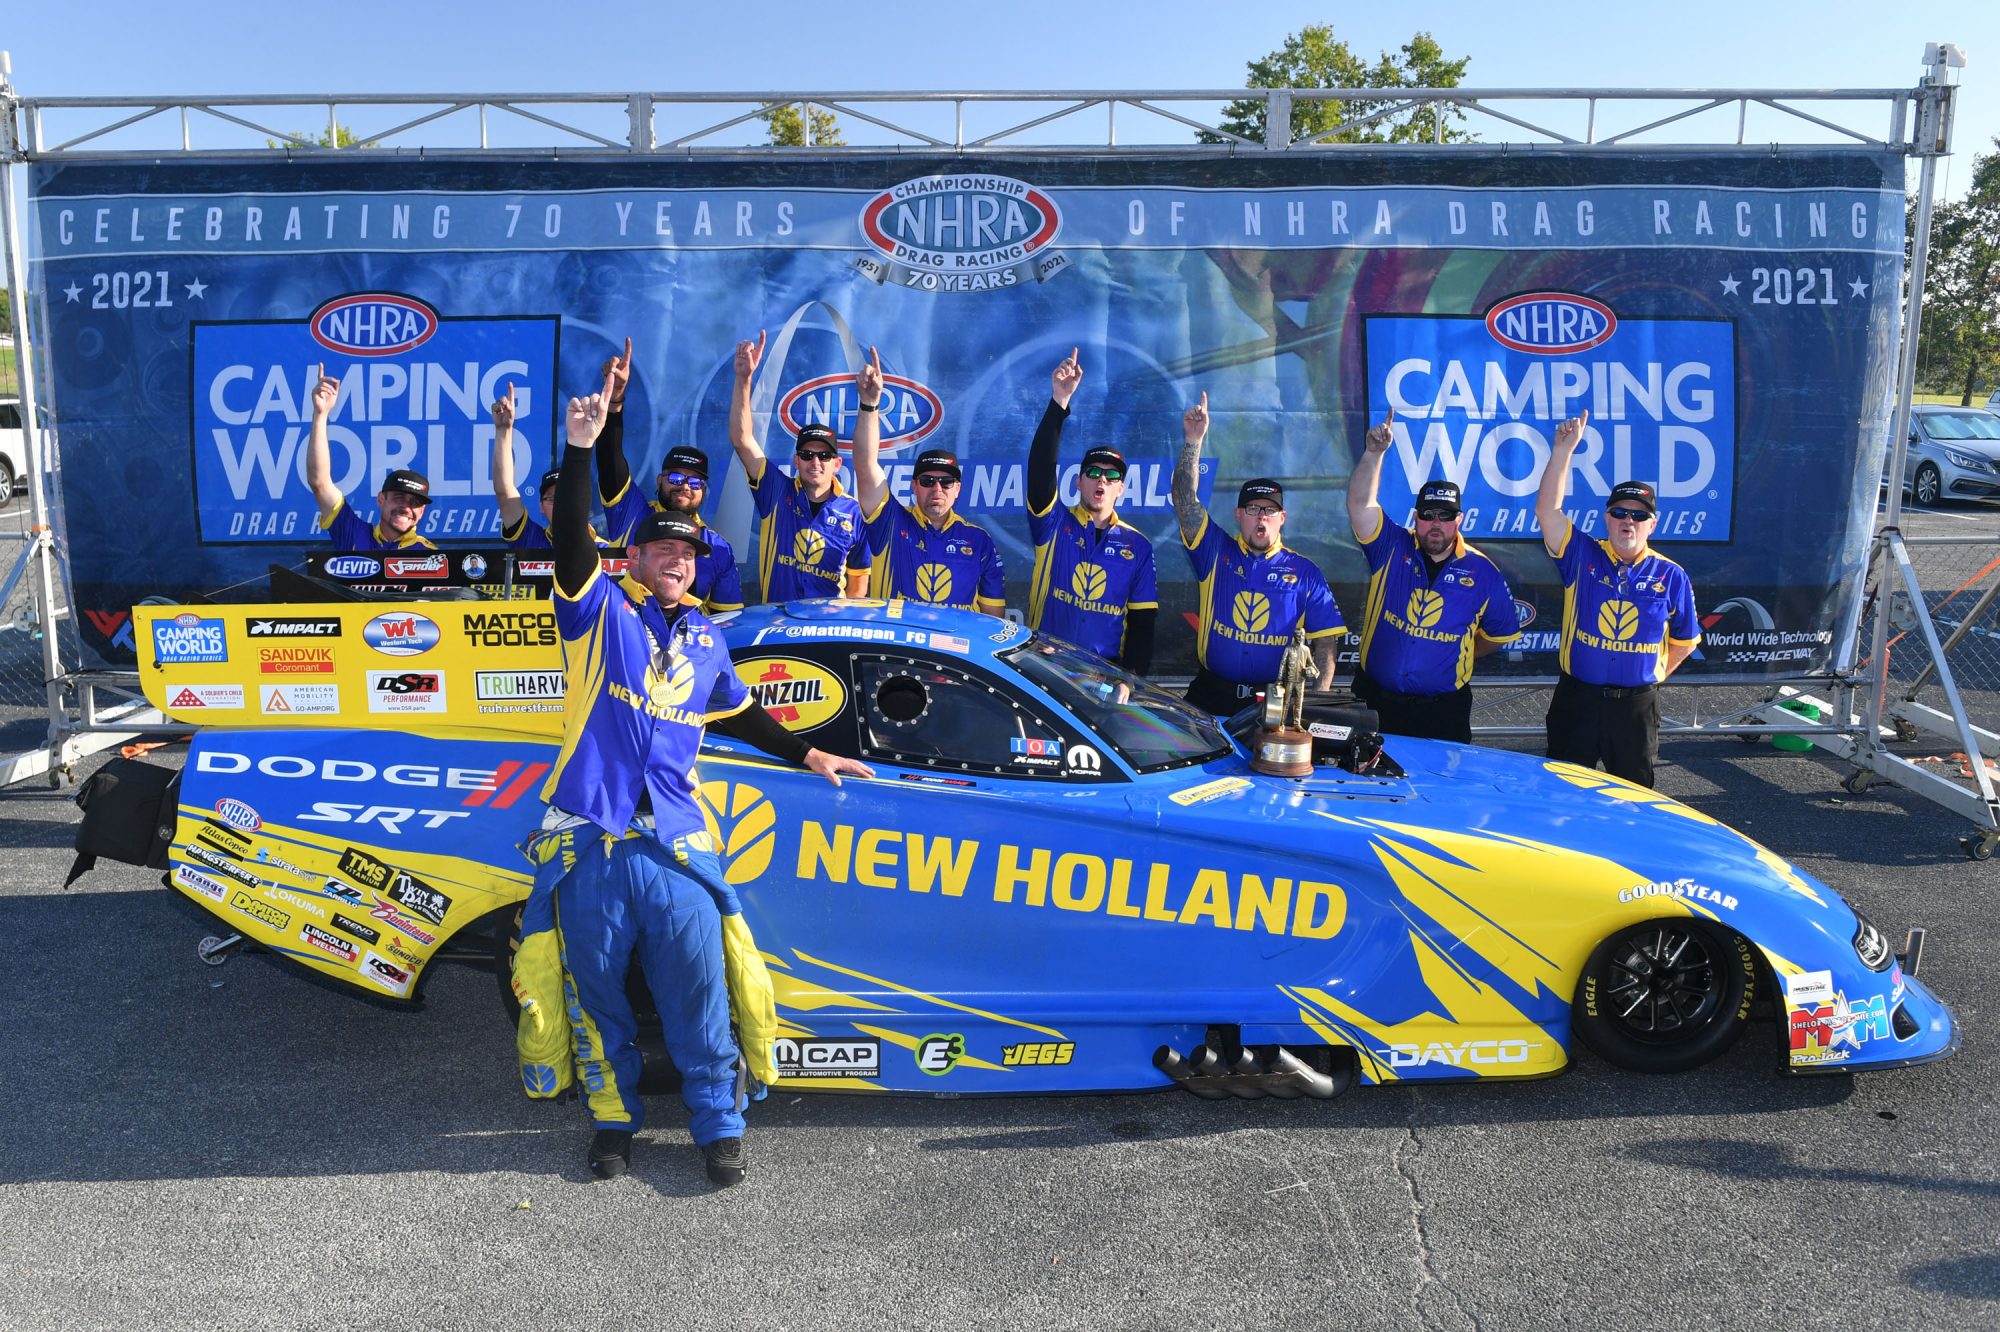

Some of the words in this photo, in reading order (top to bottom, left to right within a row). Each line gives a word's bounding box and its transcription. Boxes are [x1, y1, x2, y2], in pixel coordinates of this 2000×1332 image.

[895, 178, 1025, 199] CHAMPIONSHIP
[59, 203, 451, 245] CELEBRATING
[505, 204, 561, 238] 70
[615, 201, 794, 236] YEARS
[897, 194, 1029, 248] NHRA
[1128, 200, 1185, 236] OF
[1244, 200, 1392, 236] NHRA
[1449, 200, 1595, 237] DRAG
[1654, 200, 1867, 239] RACING
[855, 258, 881, 275] 1951
[895, 245, 945, 267] DRAG
[955, 246, 1023, 267] RACING
[1040, 255, 1067, 274] 2021
[92, 270, 173, 310] 2021
[906, 270, 938, 289] 70
[939, 268, 1017, 291] YEARS
[1751, 268, 1839, 304] 2021
[329, 305, 419, 345] NHRA
[1505, 303, 1598, 343] NHRA
[209, 359, 531, 425] CAMPING
[1384, 357, 1715, 423] CAMPING
[211, 424, 533, 501] WORLD
[229, 511, 298, 536] DRAG
[425, 508, 503, 534] SERIE
[325, 557, 379, 575] CLEVITE
[778, 554, 797, 567] NEW
[797, 563, 840, 582] HOLLAND
[1052, 588, 1073, 603] NEW
[1074, 598, 1123, 617] HOLLAND
[177, 615, 198, 625] NHRA
[273, 623, 338, 634] IMPACT
[464, 612, 556, 630] MATCO
[1383, 609, 1405, 630] NEW
[1405, 624, 1461, 643] HOLLAND
[156, 627, 222, 641] CAMPING
[380, 638, 407, 647] Western
[408, 638, 423, 646] Tech
[464, 630, 557, 647] TOOLS
[786, 625, 927, 644] @MattHagan_FC
[1214, 620, 1234, 639] NEW
[1234, 631, 1288, 646] HOLLAND
[1576, 628, 1600, 650] NEW
[1601, 638, 1659, 654] HOLLAND
[1706, 632, 1744, 647] World
[1748, 631, 1778, 646] Wide
[1779, 630, 1833, 645] Technology
[157, 639, 223, 655] WORLD
[259, 648, 333, 662] SANDVIK
[1755, 647, 1817, 662] RACEWAY
[275, 663, 320, 672] Coromant
[376, 673, 437, 694] DSR
[481, 675, 565, 695] TRUHARV
[748, 680, 824, 708] NNZOIL
[383, 695, 432, 703] PERFORMANCE
[478, 702, 565, 714] truharvestfarm
[608, 681, 641, 711] NEW
[645, 699, 706, 728] HOLLAND
[1015, 739, 1059, 755] IOA
[197, 751, 498, 791] DODGE
[1026, 758, 1061, 767] IMPACT
[1068, 768, 1102, 777] MOPAR
[221, 803, 255, 828] NHRA
[296, 802, 471, 834] SRT
[201, 825, 225, 842] Atlas
[224, 836, 249, 855] Copco
[188, 844, 261, 884] HANGSTERFER'S
[270, 856, 317, 882] stratasys
[349, 851, 387, 882] TMS
[181, 867, 225, 894] Strange
[344, 866, 380, 888] TITANIUM
[397, 873, 430, 900] TWIN
[796, 821, 979, 897] NEW
[993, 845, 1348, 940] HOLLAND
[278, 888, 326, 919] OKUMA
[322, 888, 358, 909] CARRILLO
[399, 889, 445, 919] PALMS
[1618, 879, 1739, 911] GOODYEAR
[305, 925, 351, 951] LINCOLN
[337, 916, 375, 936] TREND
[311, 937, 351, 960] WELDERS
[386, 945, 423, 967] SUNOCO
[1733, 935, 1756, 1021] GOODYEAR
[1586, 975, 1598, 1017] EAGLE
[1792, 1020, 1822, 1030] SHELOR
[807, 1046, 872, 1063] CAP
[1003, 1043, 1075, 1065] JEGS
[1390, 1040, 1528, 1067] DAYCO
